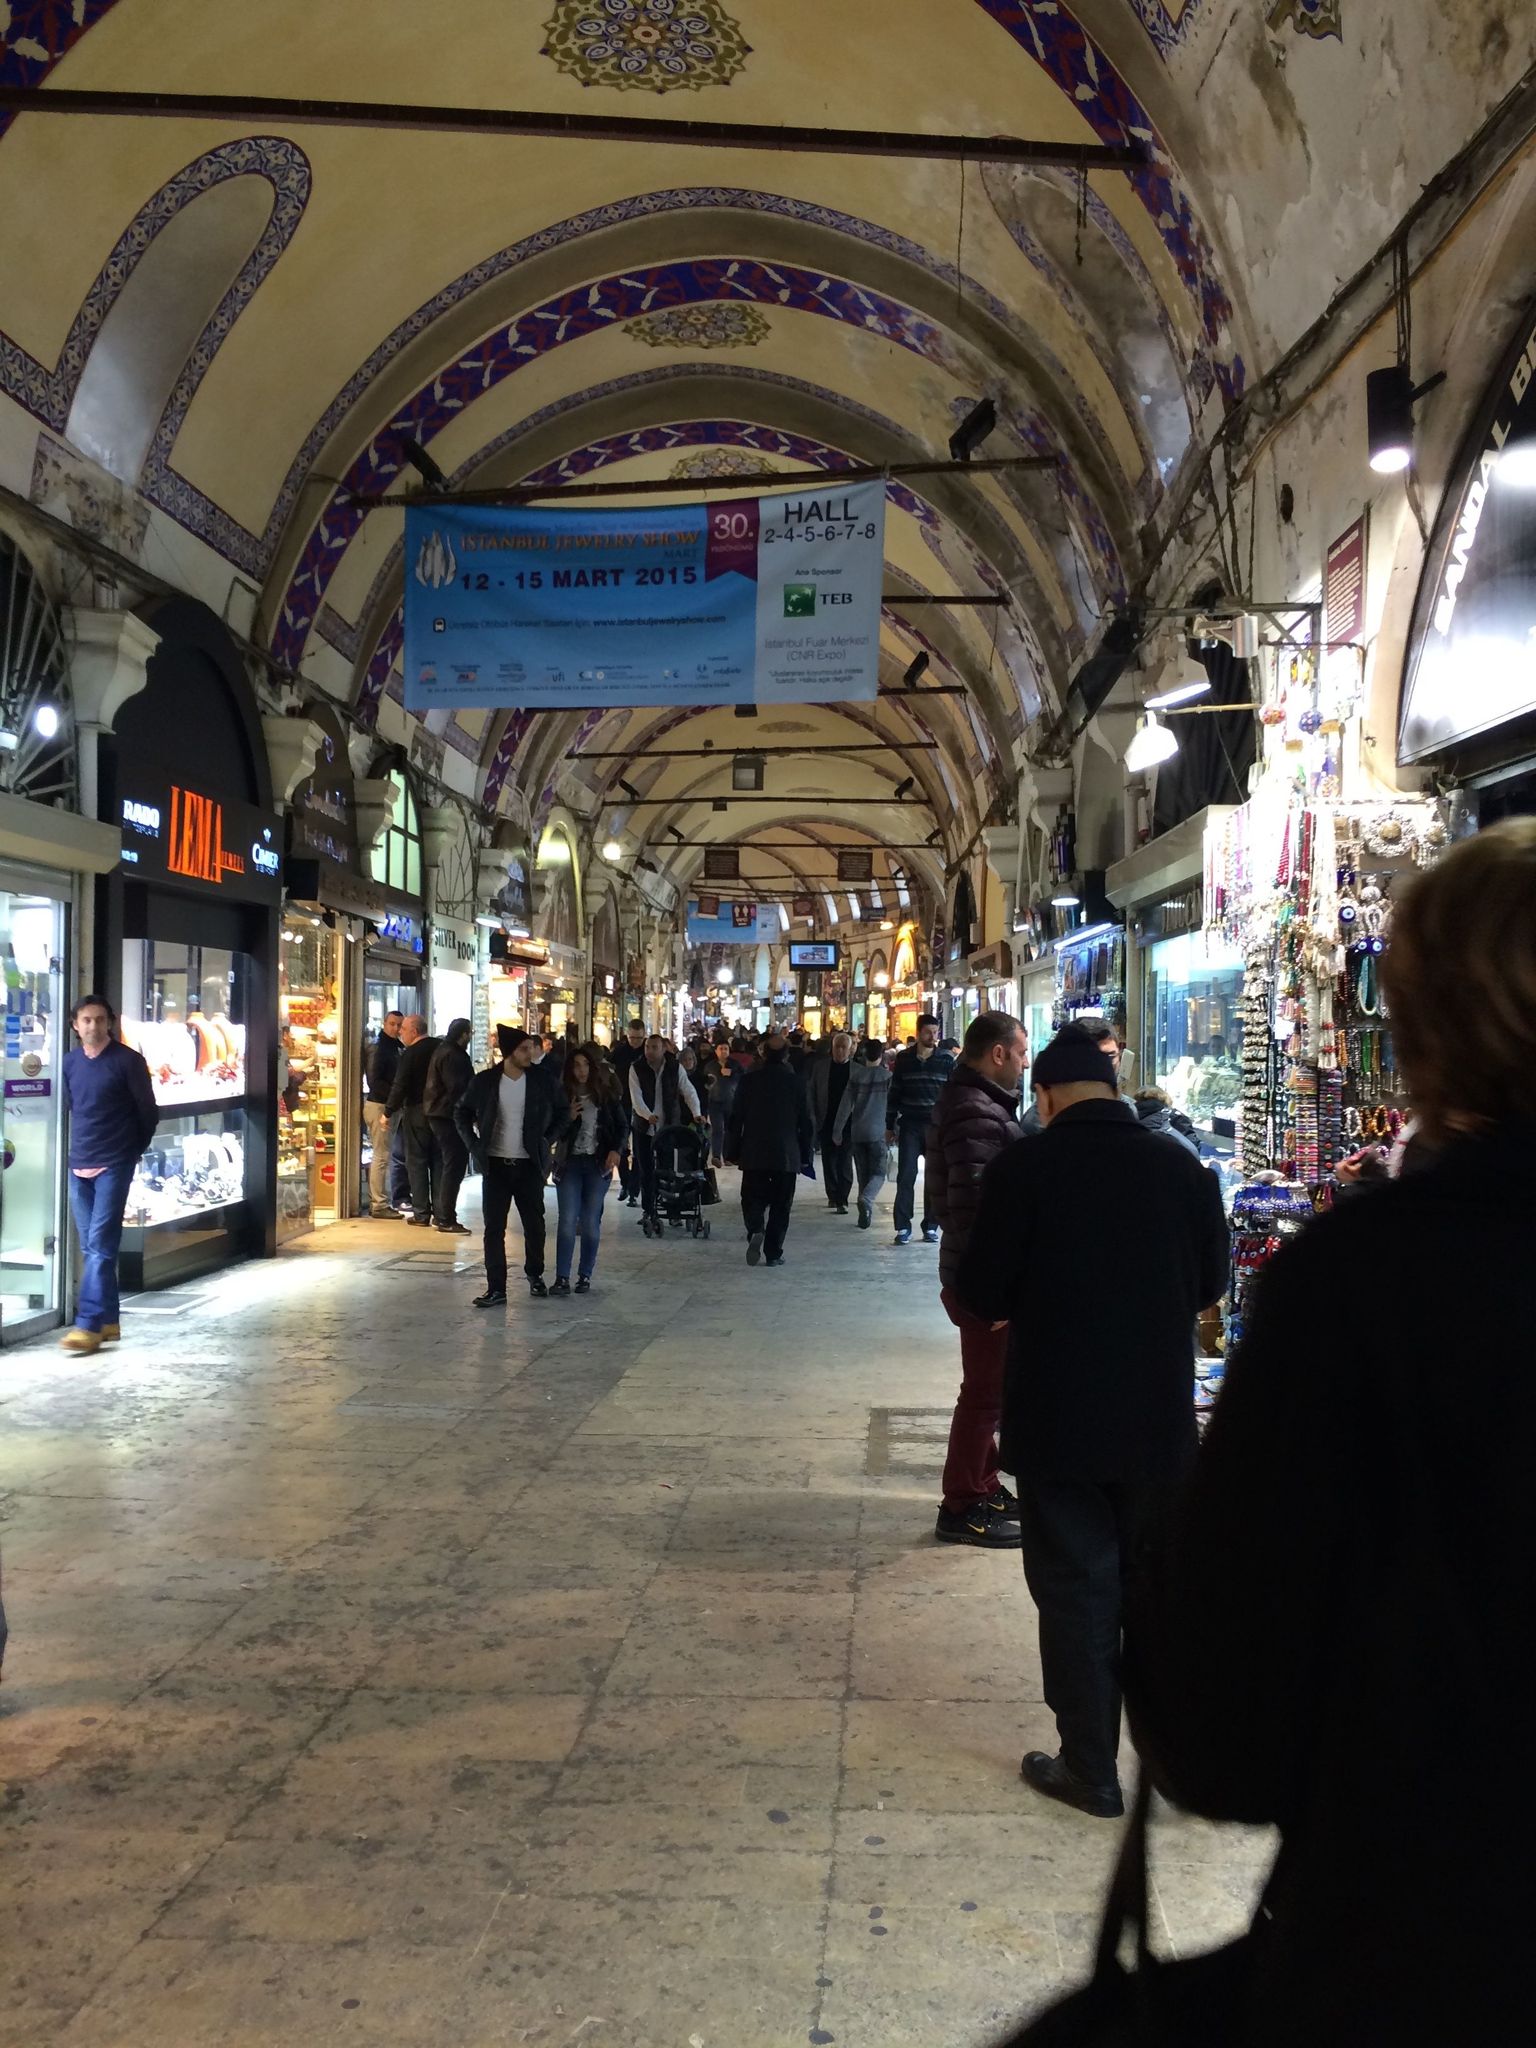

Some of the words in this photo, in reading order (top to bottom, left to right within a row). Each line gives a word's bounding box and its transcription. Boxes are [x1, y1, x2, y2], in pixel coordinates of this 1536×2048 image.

[784, 498, 859, 524] HALL
[714, 513, 754, 540] 30.
[764, 523, 876, 543] 2-4-5-6-7-8
[1434, 420, 1512, 637] SANDAL
[555, 531, 639, 551] JEWELRY
[642, 530, 702, 547] SHOW
[462, 573, 489, 590] 12
[515, 571, 543, 589] 15
[552, 569, 625, 588] MART
[635, 566, 698, 586] 2015
[819, 592, 853, 605] TEB
[806, 637, 827, 648] Fuar
[831, 636, 869, 647] Merkezi
[787, 650, 815, 661] (CNR
[817, 648, 846, 661] Expo)
[123, 800, 160, 829] RADO
[168, 785, 223, 884] LEMA
[434, 926, 457, 950] SILVER
[457, 939, 477, 964] ROOM
[11, 1084, 44, 1093] WORLD
